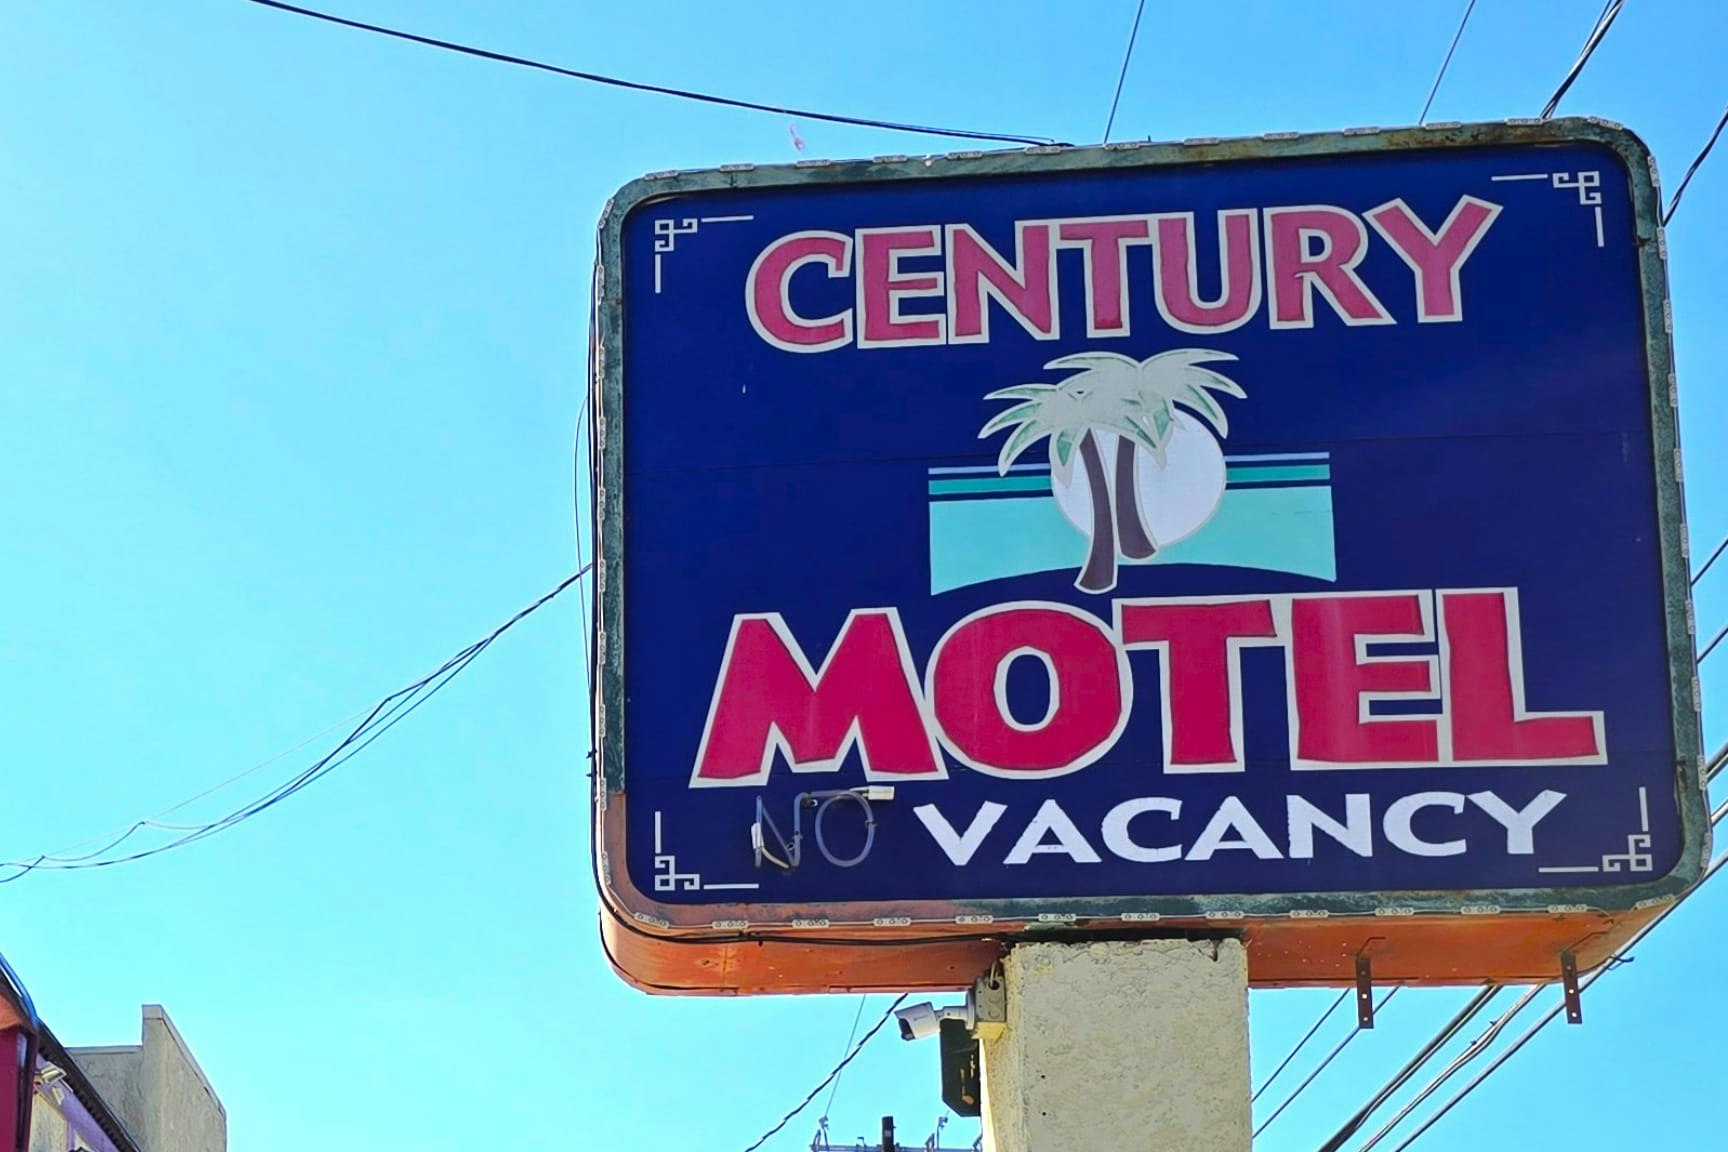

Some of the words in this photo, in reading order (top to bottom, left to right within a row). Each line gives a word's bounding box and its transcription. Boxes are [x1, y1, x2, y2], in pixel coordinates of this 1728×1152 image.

[745, 195, 1502, 354] CENTURY
[689, 587, 1606, 789] MOTEL
[752, 788, 877, 869] NO
[913, 790, 1568, 866] VACANCY
